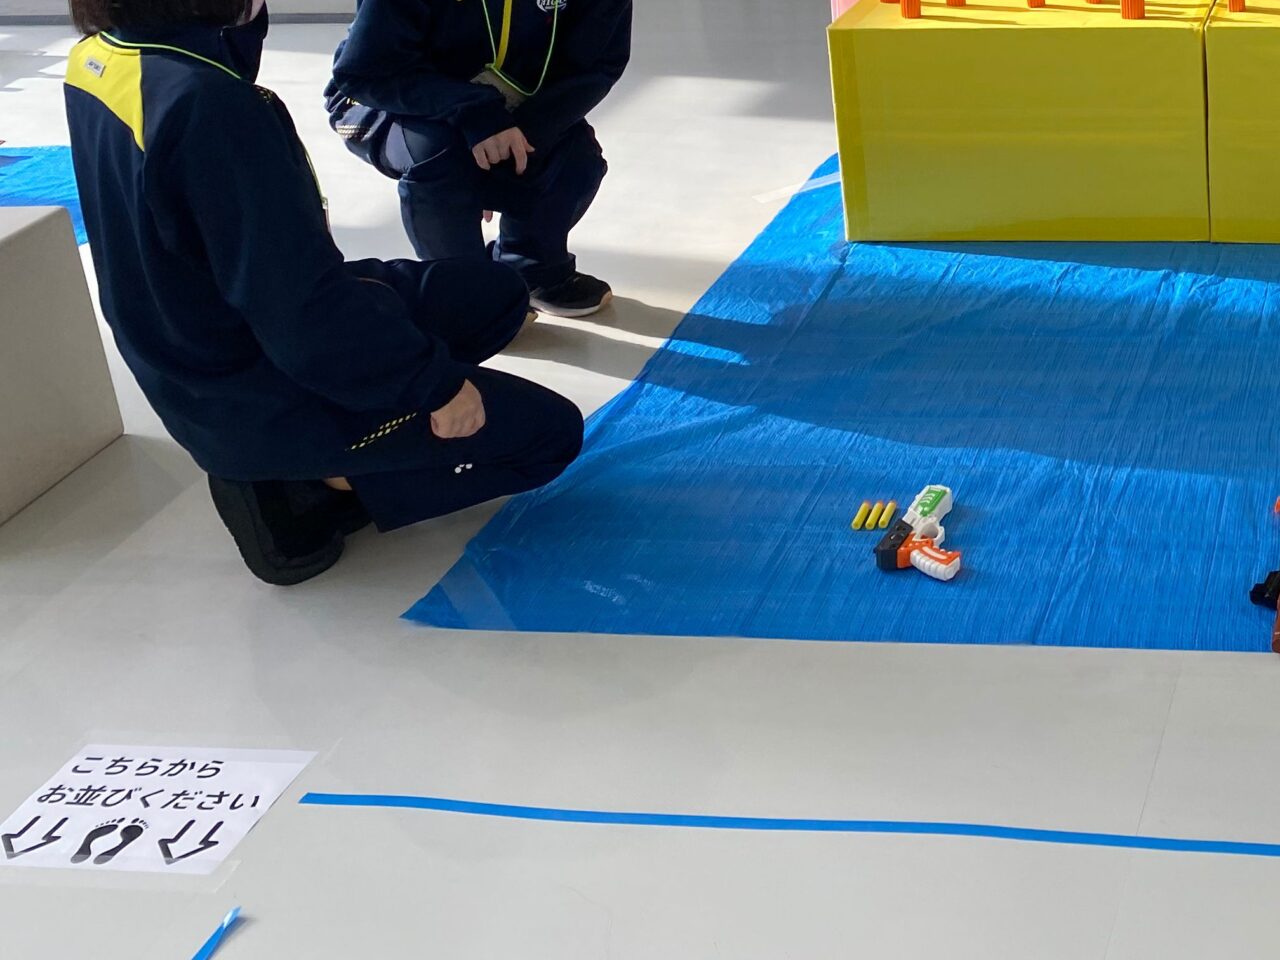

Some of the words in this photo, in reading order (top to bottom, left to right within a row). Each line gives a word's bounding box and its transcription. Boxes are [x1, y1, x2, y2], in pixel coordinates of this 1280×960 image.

[71, 756, 224, 779] こちらから
[37, 784, 260, 810] お並びください
